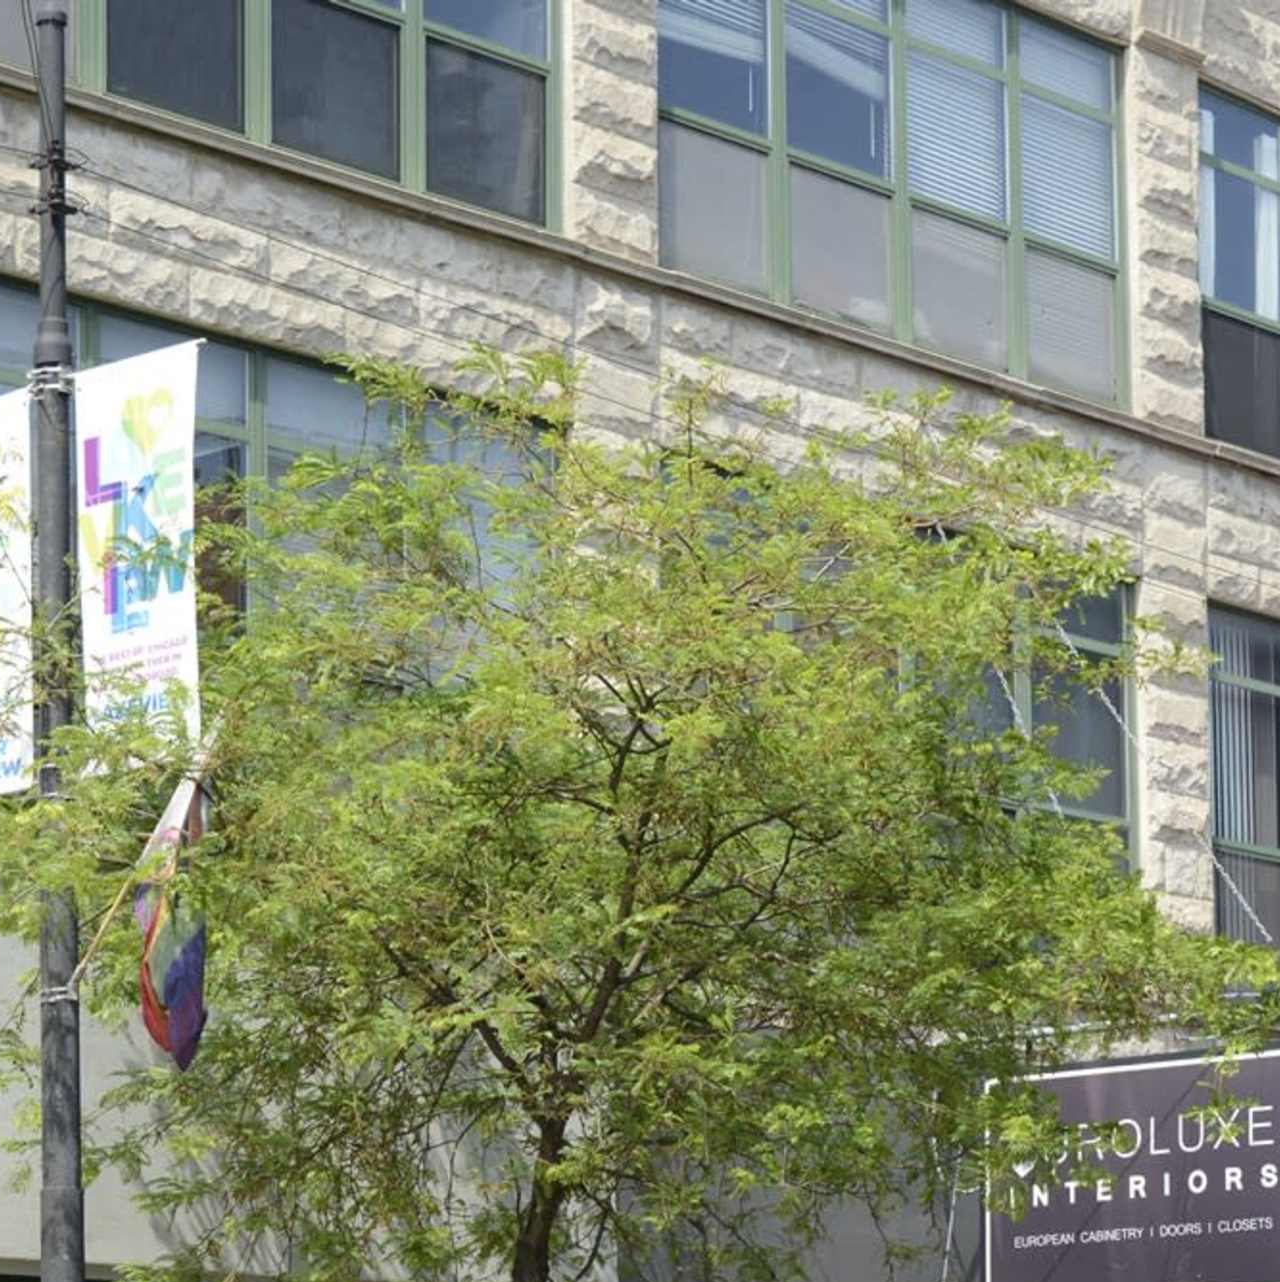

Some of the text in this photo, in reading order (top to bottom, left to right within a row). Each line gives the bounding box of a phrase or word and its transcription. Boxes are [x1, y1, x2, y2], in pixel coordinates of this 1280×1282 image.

[1009, 1163, 1280, 1210] INTERIORS
[1014, 1217, 1274, 1249] EUROPEAN CABINETRY DOORS CLOSETS
